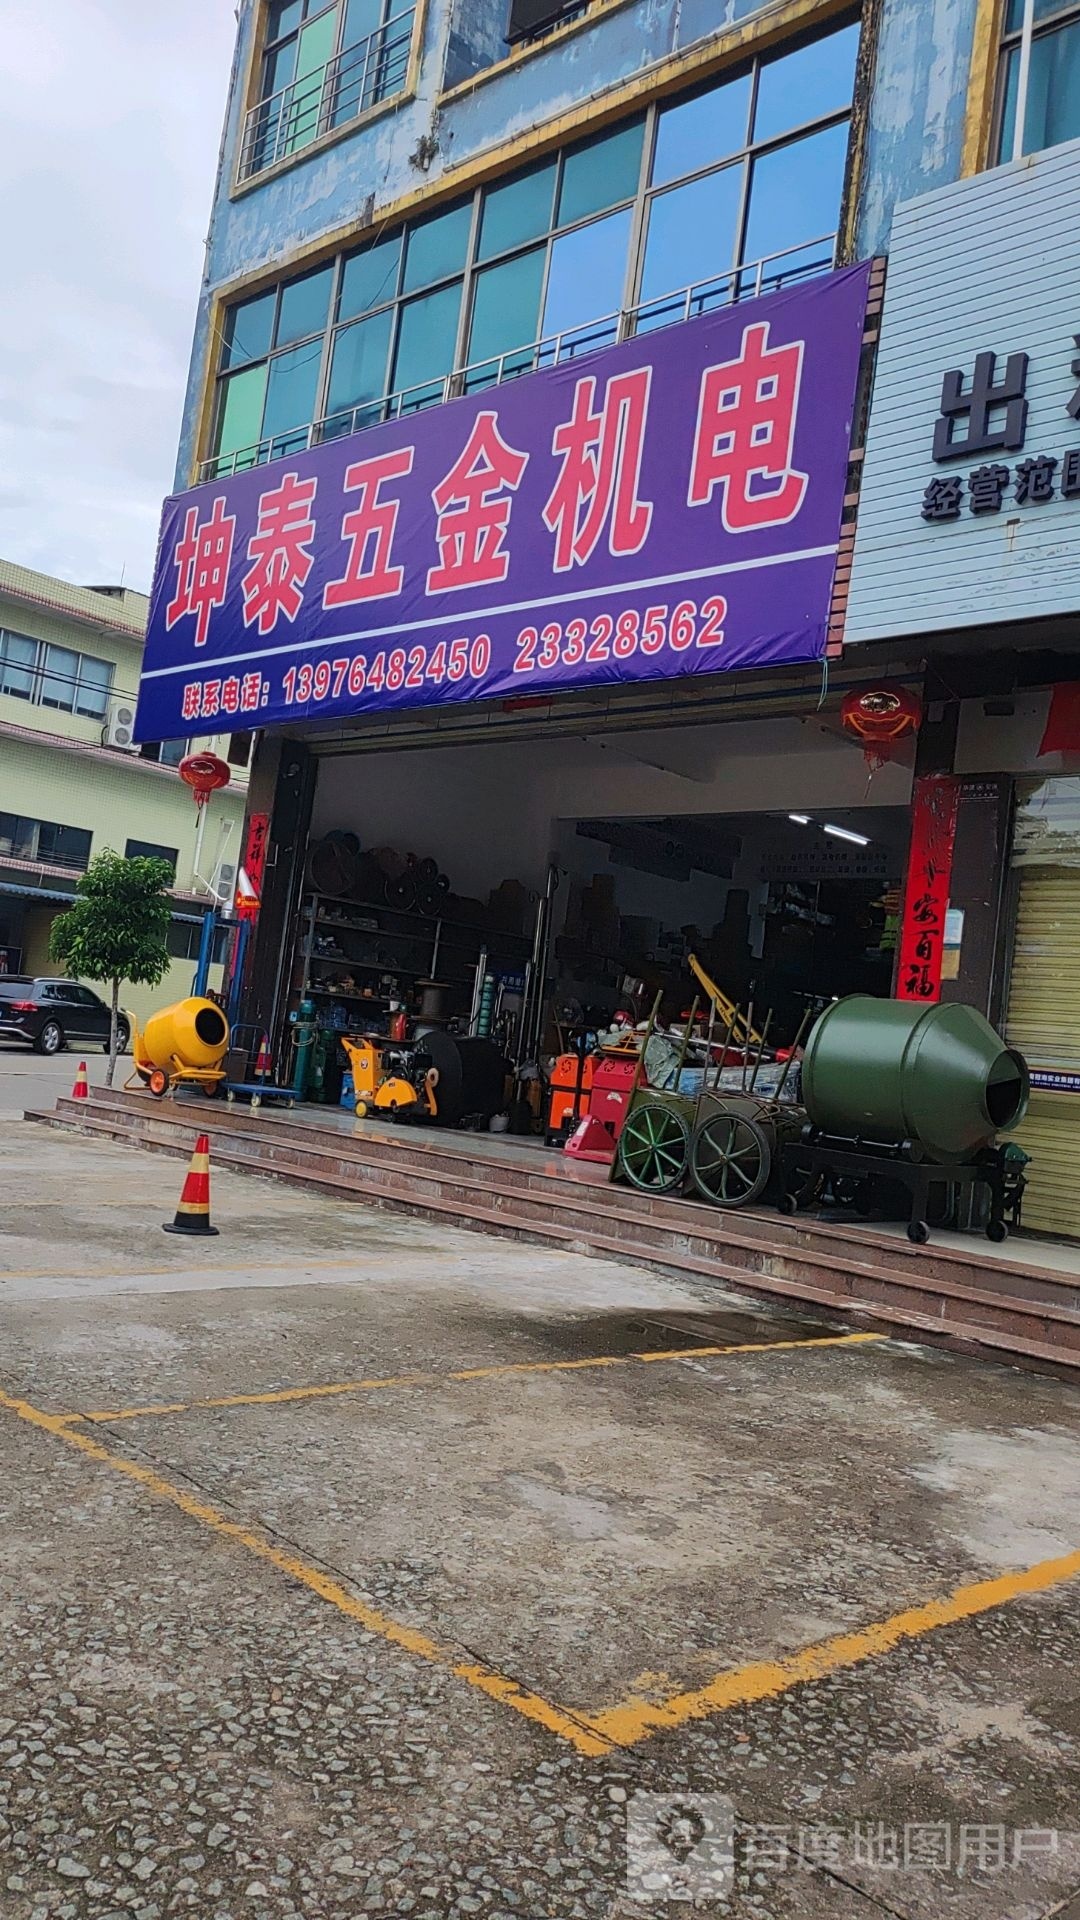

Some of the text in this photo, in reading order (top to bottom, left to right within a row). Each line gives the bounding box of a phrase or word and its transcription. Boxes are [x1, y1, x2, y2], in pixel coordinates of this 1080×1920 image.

[166, 321, 809, 647] 坤泰五金机电
[282, 634, 491, 704] 13976482450
[513, 595, 728, 673] 23328562
